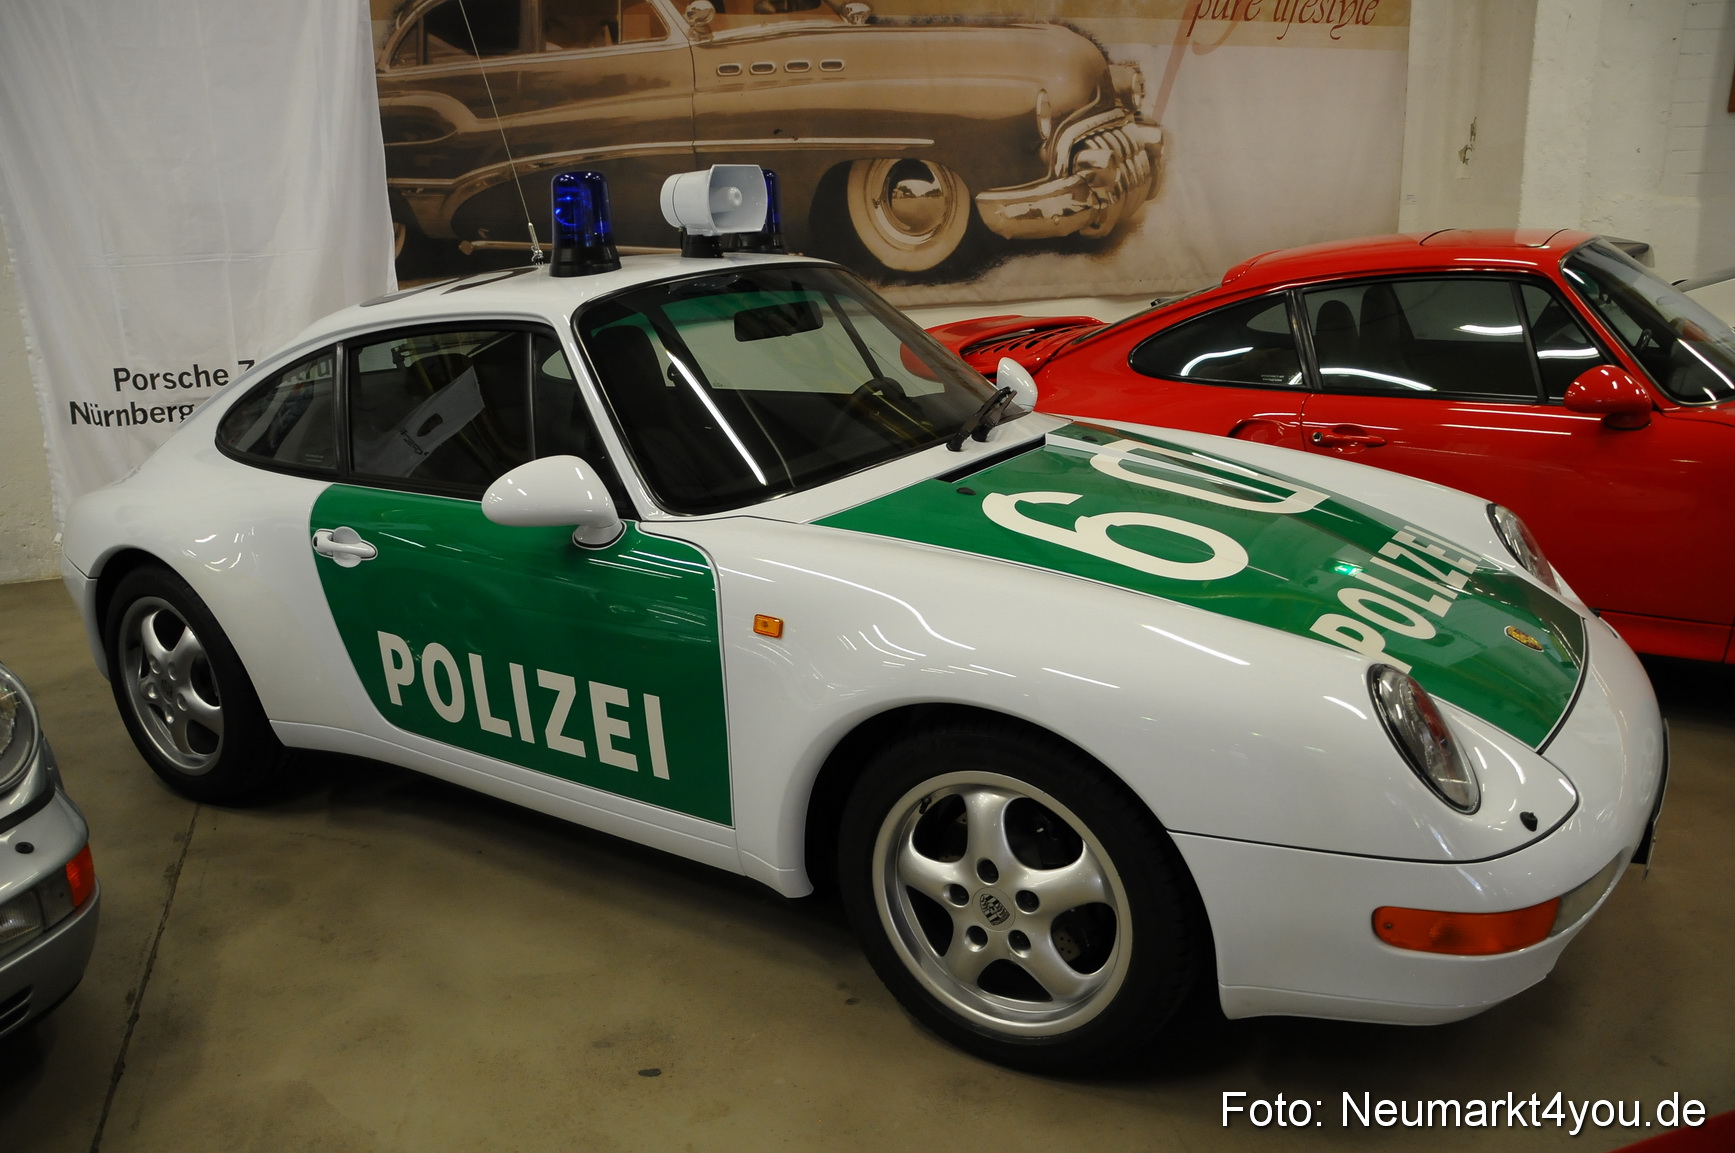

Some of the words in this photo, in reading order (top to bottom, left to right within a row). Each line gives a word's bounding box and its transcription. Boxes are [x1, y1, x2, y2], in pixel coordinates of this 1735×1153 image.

[69, 401, 195, 427] Nürnberg
[113, 363, 229, 392] Porsche
[1309, 525, 1483, 675] POLIZEI
[377, 630, 670, 780] POLIZEI
